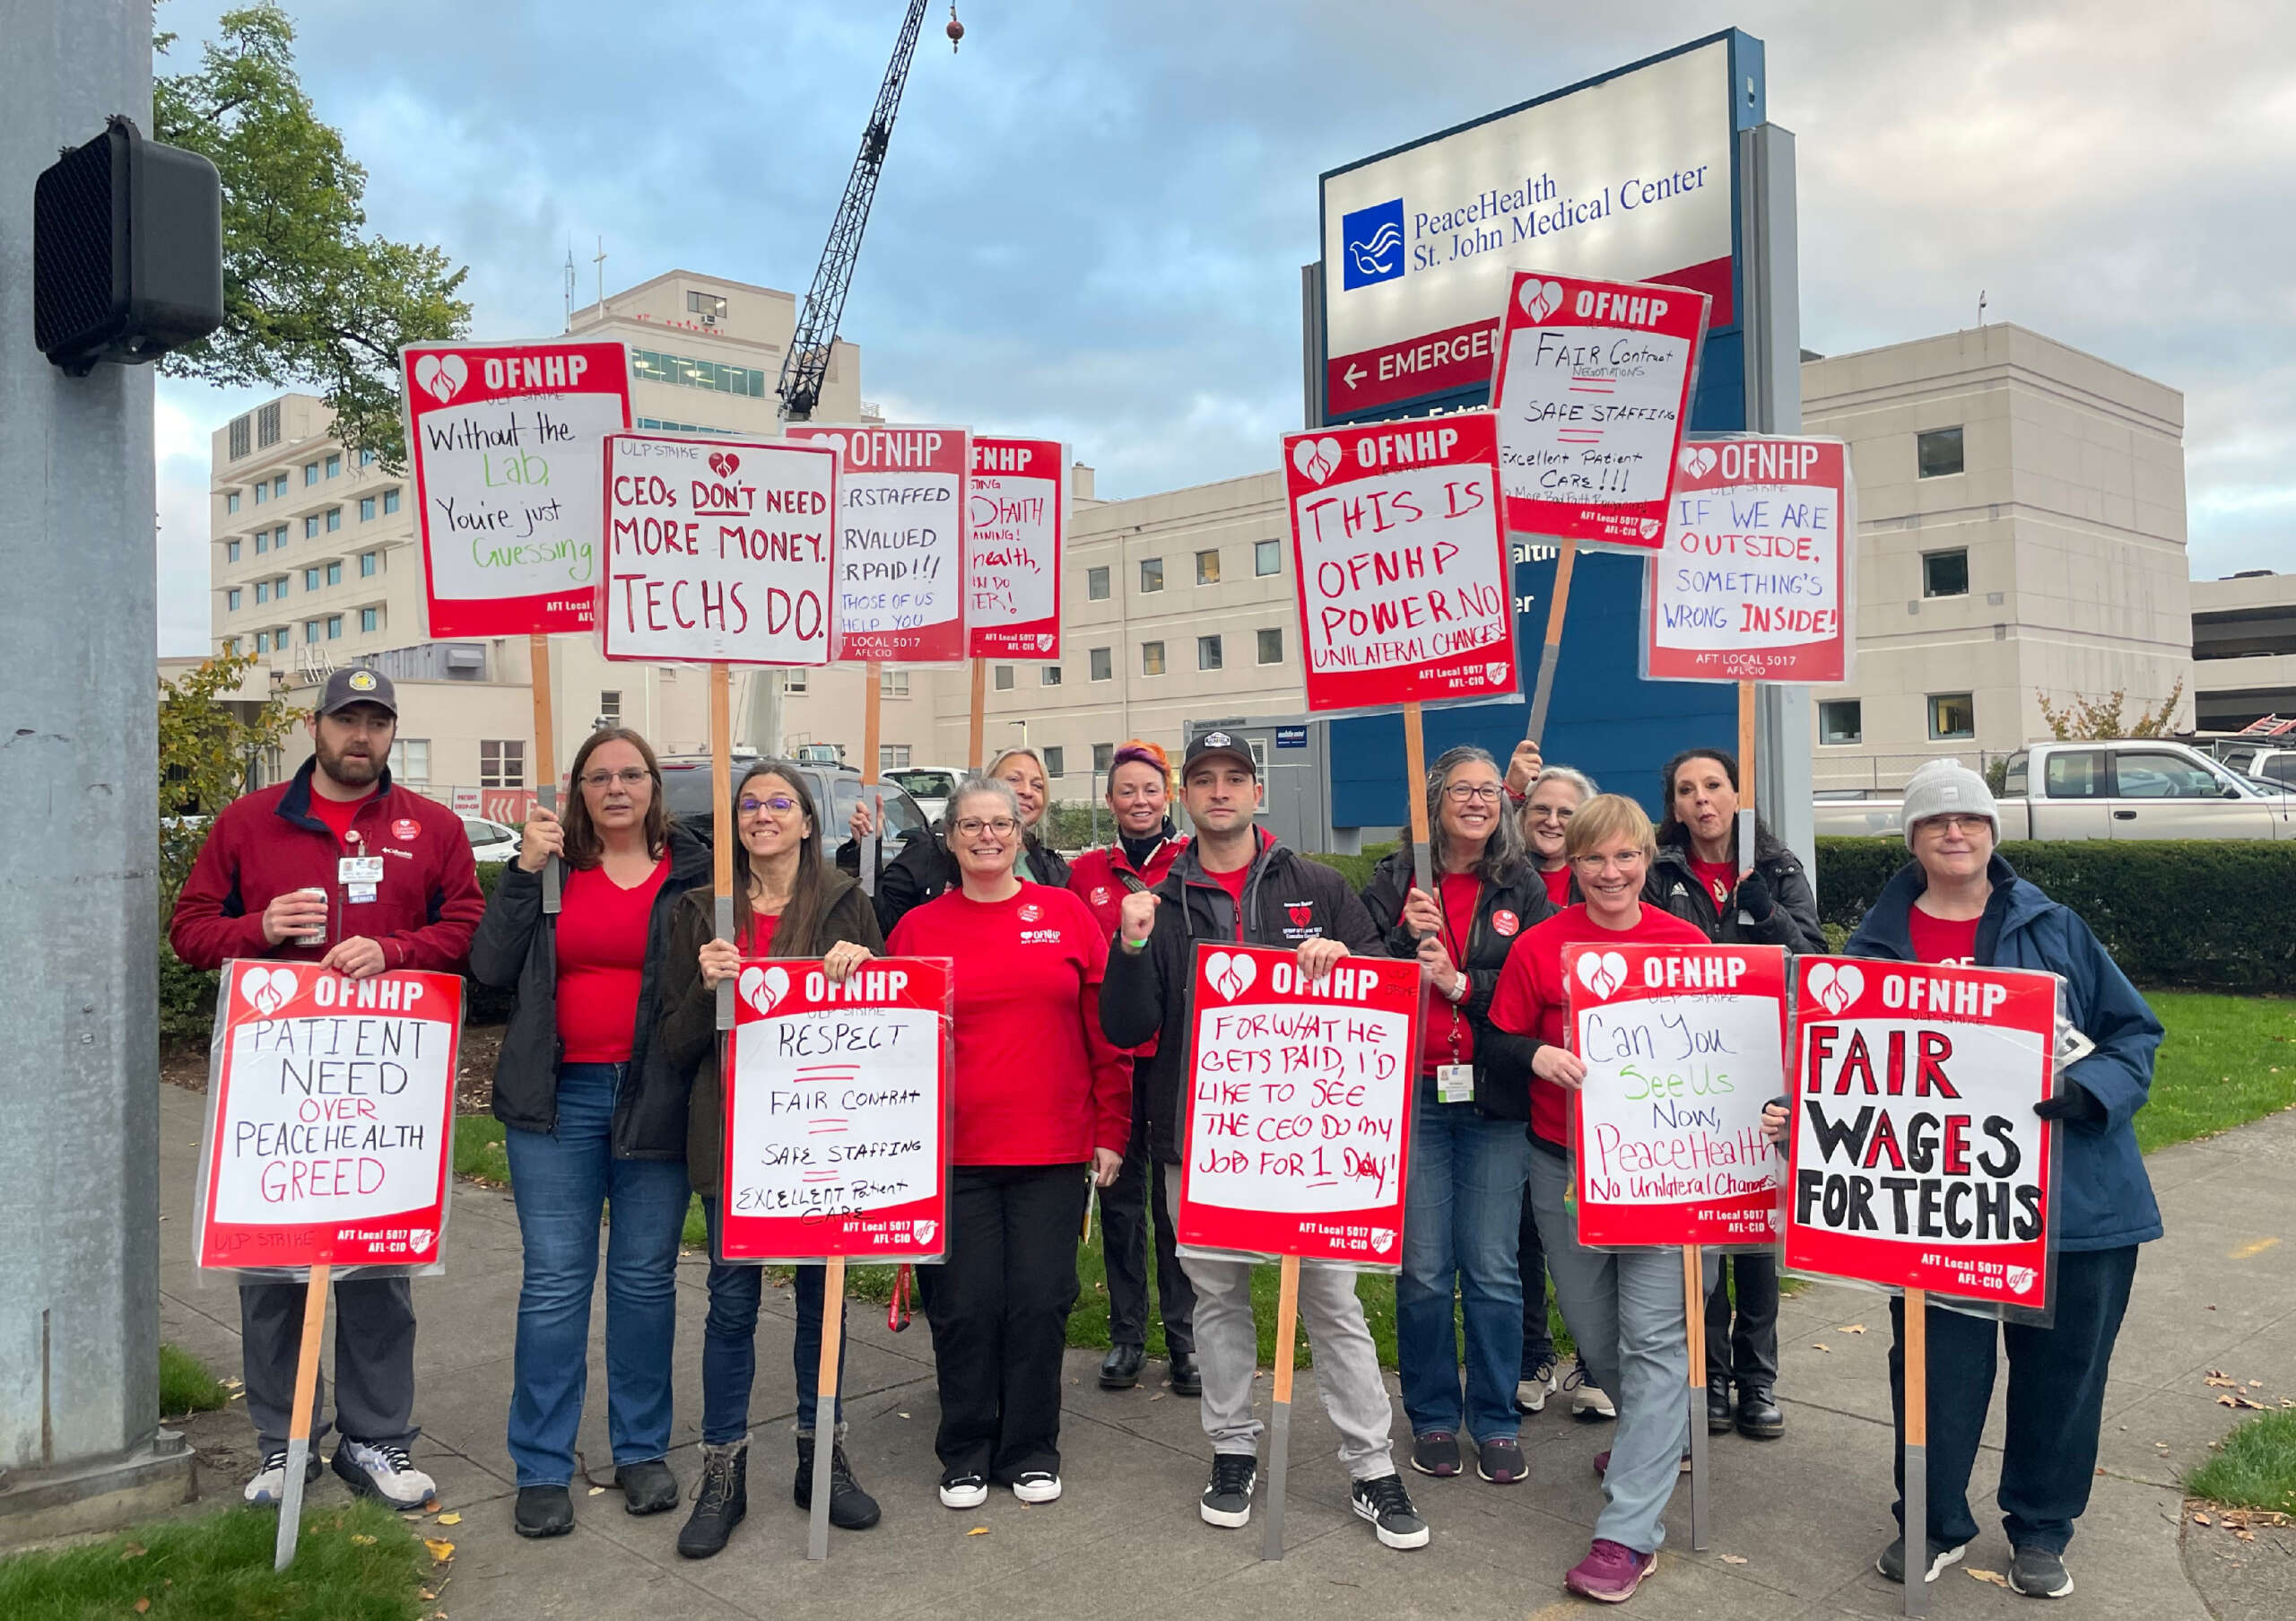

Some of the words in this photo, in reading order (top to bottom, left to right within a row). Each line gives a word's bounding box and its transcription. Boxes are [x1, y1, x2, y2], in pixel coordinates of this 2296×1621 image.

[1413, 244, 1441, 271] St.
[1449, 220, 1503, 261] John
[1511, 187, 1612, 244] Medical
[1620, 165, 1708, 210] Center
[1414, 173, 1557, 240] PeaceHealth
[1576, 291, 1668, 326] OFNHP
[1535, 332, 1599, 367] FAIR
[484, 355, 587, 389] OFNHP
[1525, 401, 1584, 421] SAFE
[428, 417, 526, 451] Without
[537, 411, 575, 443] the
[621, 440, 650, 458] ULP
[852, 431, 942, 466] OFNHP
[972, 447, 1032, 471] FNHP
[1357, 428, 1458, 467] OFNHP
[1722, 444, 1818, 480] OFNHP
[614, 476, 676, 508] CEOs
[691, 479, 755, 511] DON'T
[767, 491, 826, 515] NEED
[843, 488, 950, 507] RSTAFFED
[435, 496, 509, 532] You're
[518, 497, 561, 537] just
[1306, 492, 1423, 542] THIS
[1444, 482, 1483, 519] IS
[1680, 500, 1711, 526] IF
[1731, 501, 1769, 529] WE
[1781, 504, 1830, 529] ARE
[614, 518, 699, 555] MORE
[719, 526, 826, 562] MONEY.
[842, 528, 936, 550] RVALUED
[474, 538, 593, 582] Guessing
[1318, 542, 1458, 597] OFNHP
[1676, 570, 1823, 596] SOMETHING'S
[547, 601, 562, 612] AFT
[565, 600, 590, 610] Local
[614, 574, 747, 633] TECHS
[767, 587, 824, 641] DO.
[892, 594, 910, 609] OF
[915, 592, 934, 606] US
[892, 614, 922, 631] YOU
[1664, 603, 1727, 629] WRONG
[1739, 603, 1837, 633] INSIDE!
[851, 637, 889, 647] LOCAL
[893, 637, 920, 647] 5017
[855, 649, 891, 657] AFL-CIO
[1313, 637, 1427, 668] UNILATERAL
[1419, 670, 1435, 679] AFT
[1437, 667, 1461, 677] Local
[1464, 665, 1483, 675] 5017
[1696, 653, 1718, 665] AFT
[1722, 654, 1763, 665] LOCAL
[1767, 657, 1796, 666] 5017
[1726, 667, 1765, 675] AFL-CIO
[1449, 676, 1484, 688] AFL-CIO
[805, 971, 909, 1001] OFNHP
[1272, 963, 1379, 1000] OFNHP
[1643, 957, 1746, 988] OFNHP
[314, 976, 424, 1011] OFNHP
[1883, 974, 2006, 1016] OFNHP
[255, 1019, 428, 1060] PATIENT
[779, 1023, 909, 1057] RESPECT
[1216, 1014, 1270, 1041] FOR
[1273, 1011, 1343, 1043] WHAT
[1348, 1024, 1388, 1043] HE
[1587, 1013, 1655, 1063] Can
[1660, 1013, 1737, 1060] You
[282, 1058, 408, 1096] NEED
[1201, 1050, 1270, 1074] GETS
[1282, 1044, 1345, 1080] PAID,
[1360, 1048, 1396, 1080] I'D
[1807, 1025, 1962, 1099] FAIR
[1198, 1080, 1252, 1105] LIKE
[1259, 1084, 1294, 1103] TO
[1311, 1078, 1366, 1109] SEE
[1620, 1064, 1683, 1100] See
[1690, 1063, 1735, 1095] Us
[299, 1098, 379, 1123] OVER
[771, 1090, 828, 1115] FAIR
[1653, 1099, 1721, 1134] Now,
[1202, 1112, 1249, 1137] THE
[1257, 1114, 1313, 1142] CEO
[1805, 1099, 2022, 1179] WAGES
[761, 1143, 817, 1165] SAFE
[1199, 1147, 1249, 1174] JOB
[1260, 1153, 1305, 1177] FOR
[1310, 1146, 1333, 1177] 1
[261, 1157, 385, 1203] GREED
[1590, 1173, 1621, 1200] No
[1631, 1172, 1710, 1198] Unilateral
[1698, 1211, 1715, 1221] AFT
[1717, 1210, 1740, 1219] Local
[1744, 1210, 1764, 1219] 5017
[1796, 1169, 1879, 1231] FOR
[1880, 1175, 2043, 1242] TECHS
[338, 1229, 355, 1241] AFT
[358, 1229, 381, 1241] Local
[386, 1229, 408, 1241] 5017
[842, 1222, 860, 1233] AFT
[863, 1220, 887, 1233] Local
[890, 1220, 910, 1232] 5017
[873, 1233, 910, 1244] AFL-CIO
[1299, 1223, 1317, 1234] AFT
[1319, 1224, 1344, 1235] Local
[1347, 1226, 1369, 1238] 5017
[1728, 1223, 1765, 1233] AFL-CIO
[369, 1242, 406, 1253] AFL-CIO
[1329, 1239, 1368, 1250] AFL-CIO
[1921, 1253, 1942, 1267] AFT
[1944, 1256, 1974, 1271] Local
[1978, 1260, 2004, 1275] 5017
[1958, 1273, 2003, 1288] AFL-CIO
